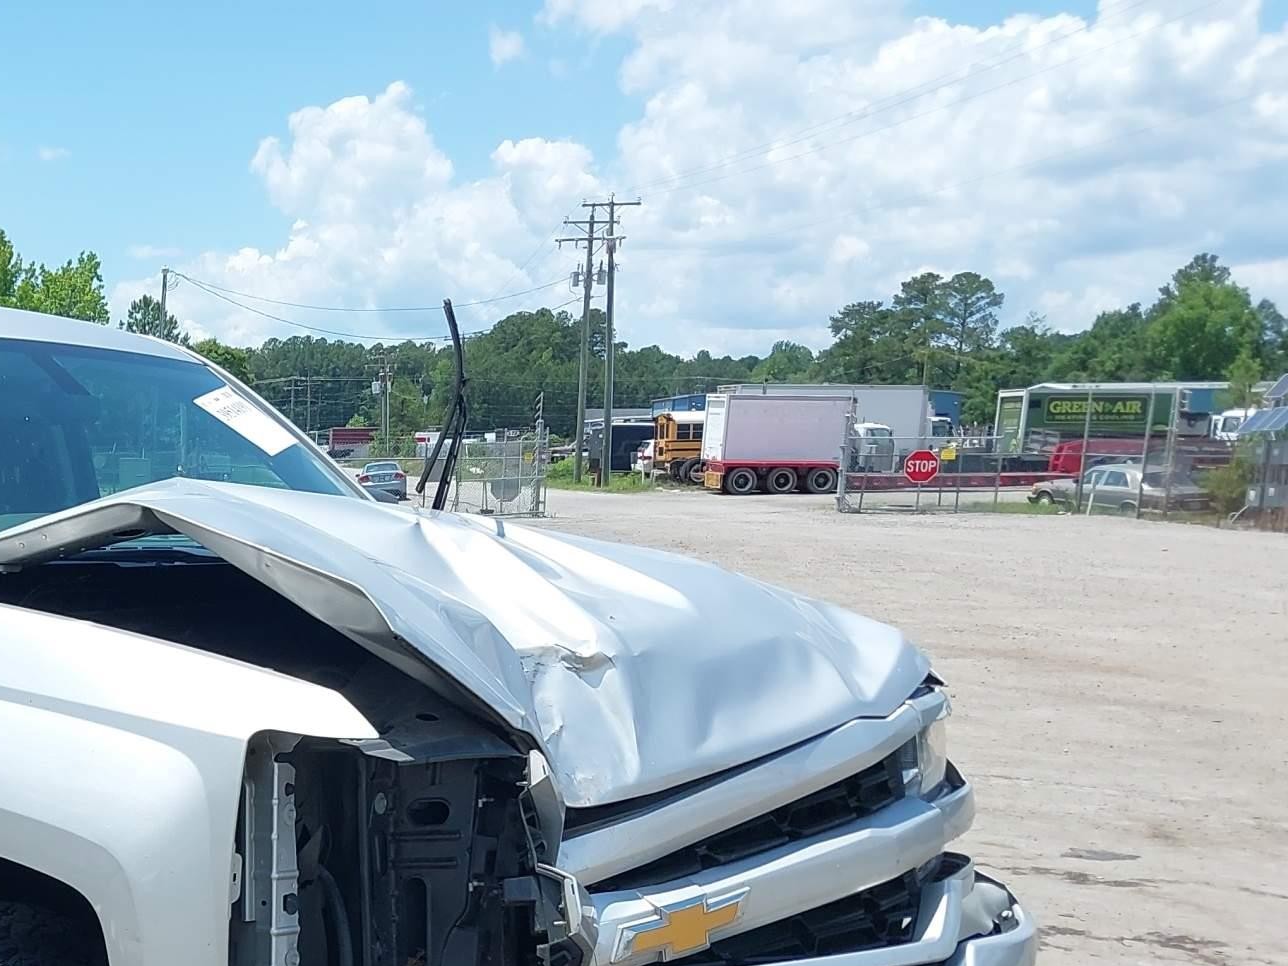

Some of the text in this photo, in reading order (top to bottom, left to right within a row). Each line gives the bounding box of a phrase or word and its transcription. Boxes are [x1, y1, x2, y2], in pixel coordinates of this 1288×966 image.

[1049, 400, 1142, 413] GREEN AIR
[906, 460, 937, 473] STOP
